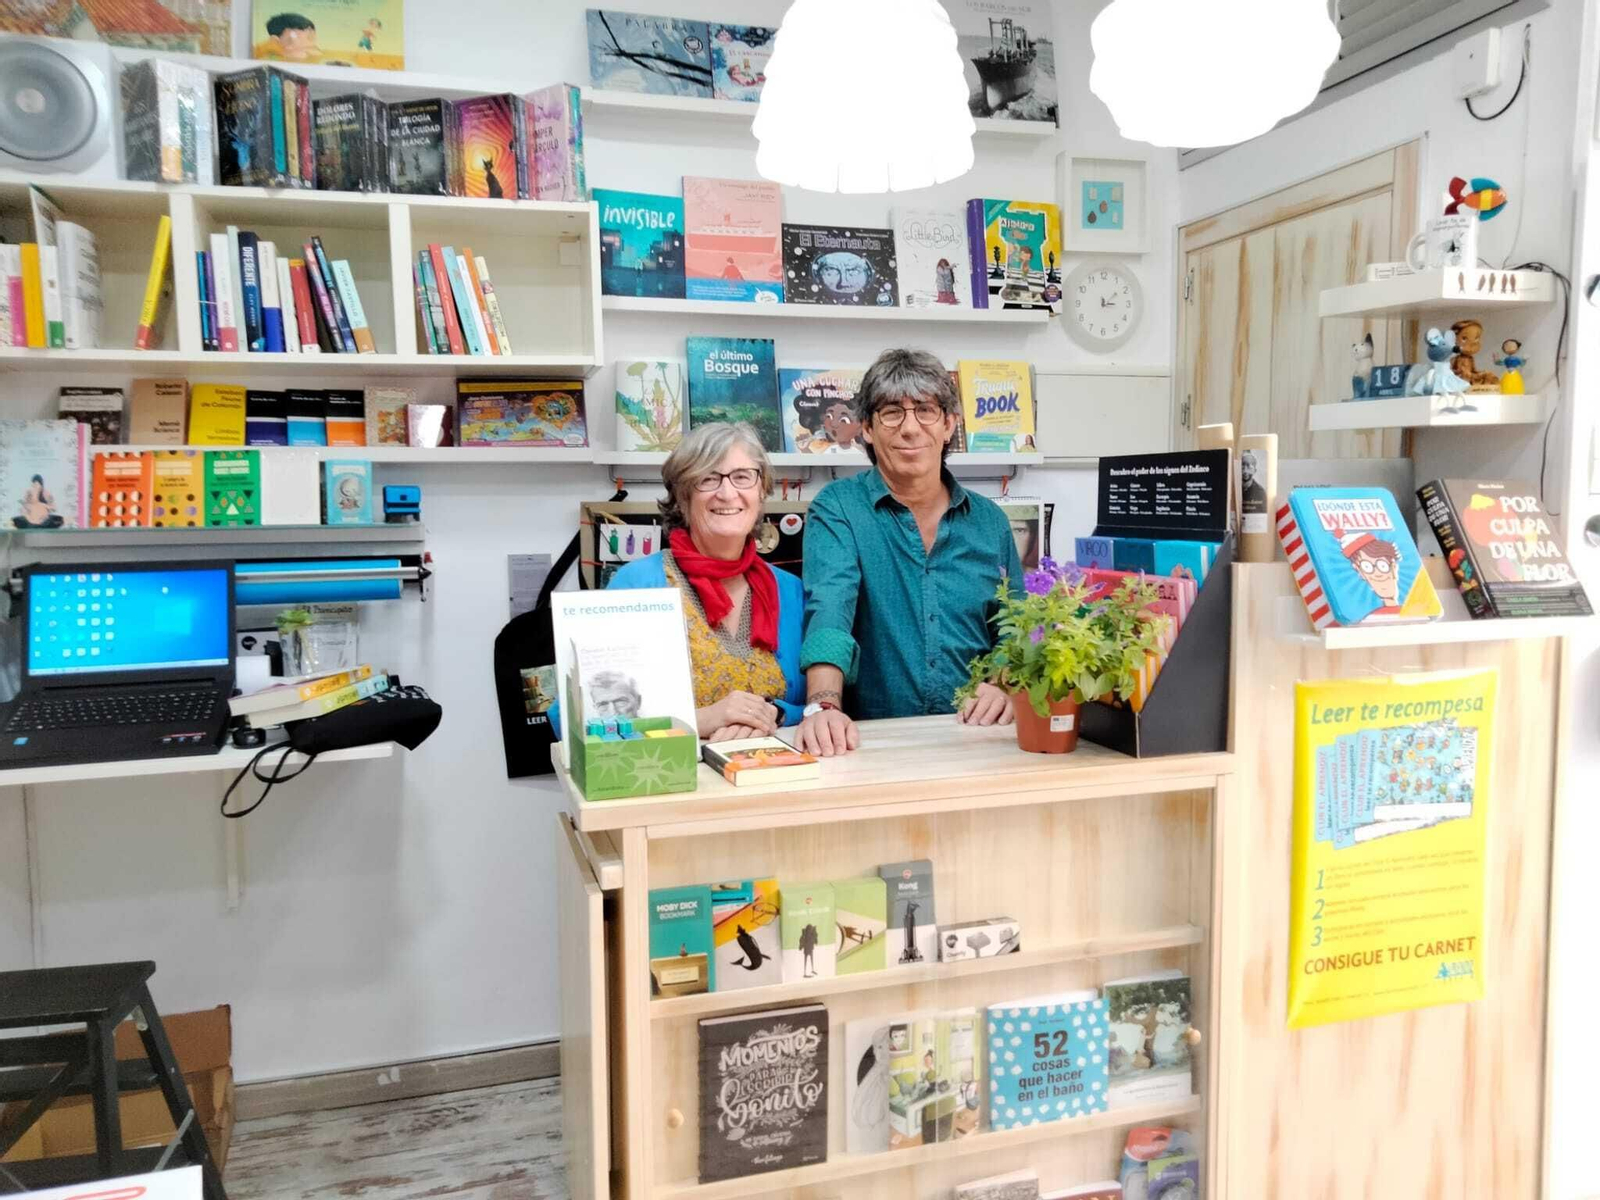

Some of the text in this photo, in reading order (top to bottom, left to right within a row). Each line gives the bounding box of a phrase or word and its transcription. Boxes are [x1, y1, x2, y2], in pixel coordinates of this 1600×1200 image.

[625, 18, 696, 33] PALABRAS
[241, 246, 257, 288] DIFERENTE
[1088, 275, 1095, 284] 11
[1100, 271, 1108, 280] 12
[1115, 276, 1119, 284] 1
[1079, 285, 1086, 294] 10
[1123, 285, 1129, 294] 2
[1075, 299, 1081, 308] 9
[1126, 299, 1131, 308] 3
[1079, 313, 1084, 322] 8
[1122, 313, 1127, 321] 4
[1089, 323, 1094, 332] 7
[1101, 327, 1106, 336] 6
[1113, 323, 1119, 332] 5
[709, 350, 754, 361] el último
[704, 359, 760, 377] Bosque
[791, 377, 862, 394] UNA CUCHAR
[805, 388, 855, 399] CON PINCHOS
[975, 392, 1021, 418] BOOK
[1499, 497, 1540, 513] POR
[1321, 512, 1389, 528] WALLY?
[1490, 517, 1551, 536] CULPA
[1489, 541, 1562, 559] DE UNA
[1522, 563, 1577, 582] FLOR
[563, 602, 675, 616] te recomendamos
[1312, 697, 1484, 724] Leer te recompesa
[526, 715, 548, 726] LEER
[1315, 869, 1325, 891] 1
[657, 900, 698, 913] MOBY DICK
[1312, 899, 1325, 921] 2
[1311, 926, 1323, 947] 3
[1304, 936, 1477, 975] CONSIGUE TU CARNET
[719, 1025, 820, 1072] MOMENTOS
[1033, 1030, 1069, 1059] 52
[1032, 1058, 1071, 1072] cosas
[750, 1068, 777, 1082] PARA
[1019, 1069, 1083, 1090] que hacer
[1018, 1082, 1084, 1102] en el baño
